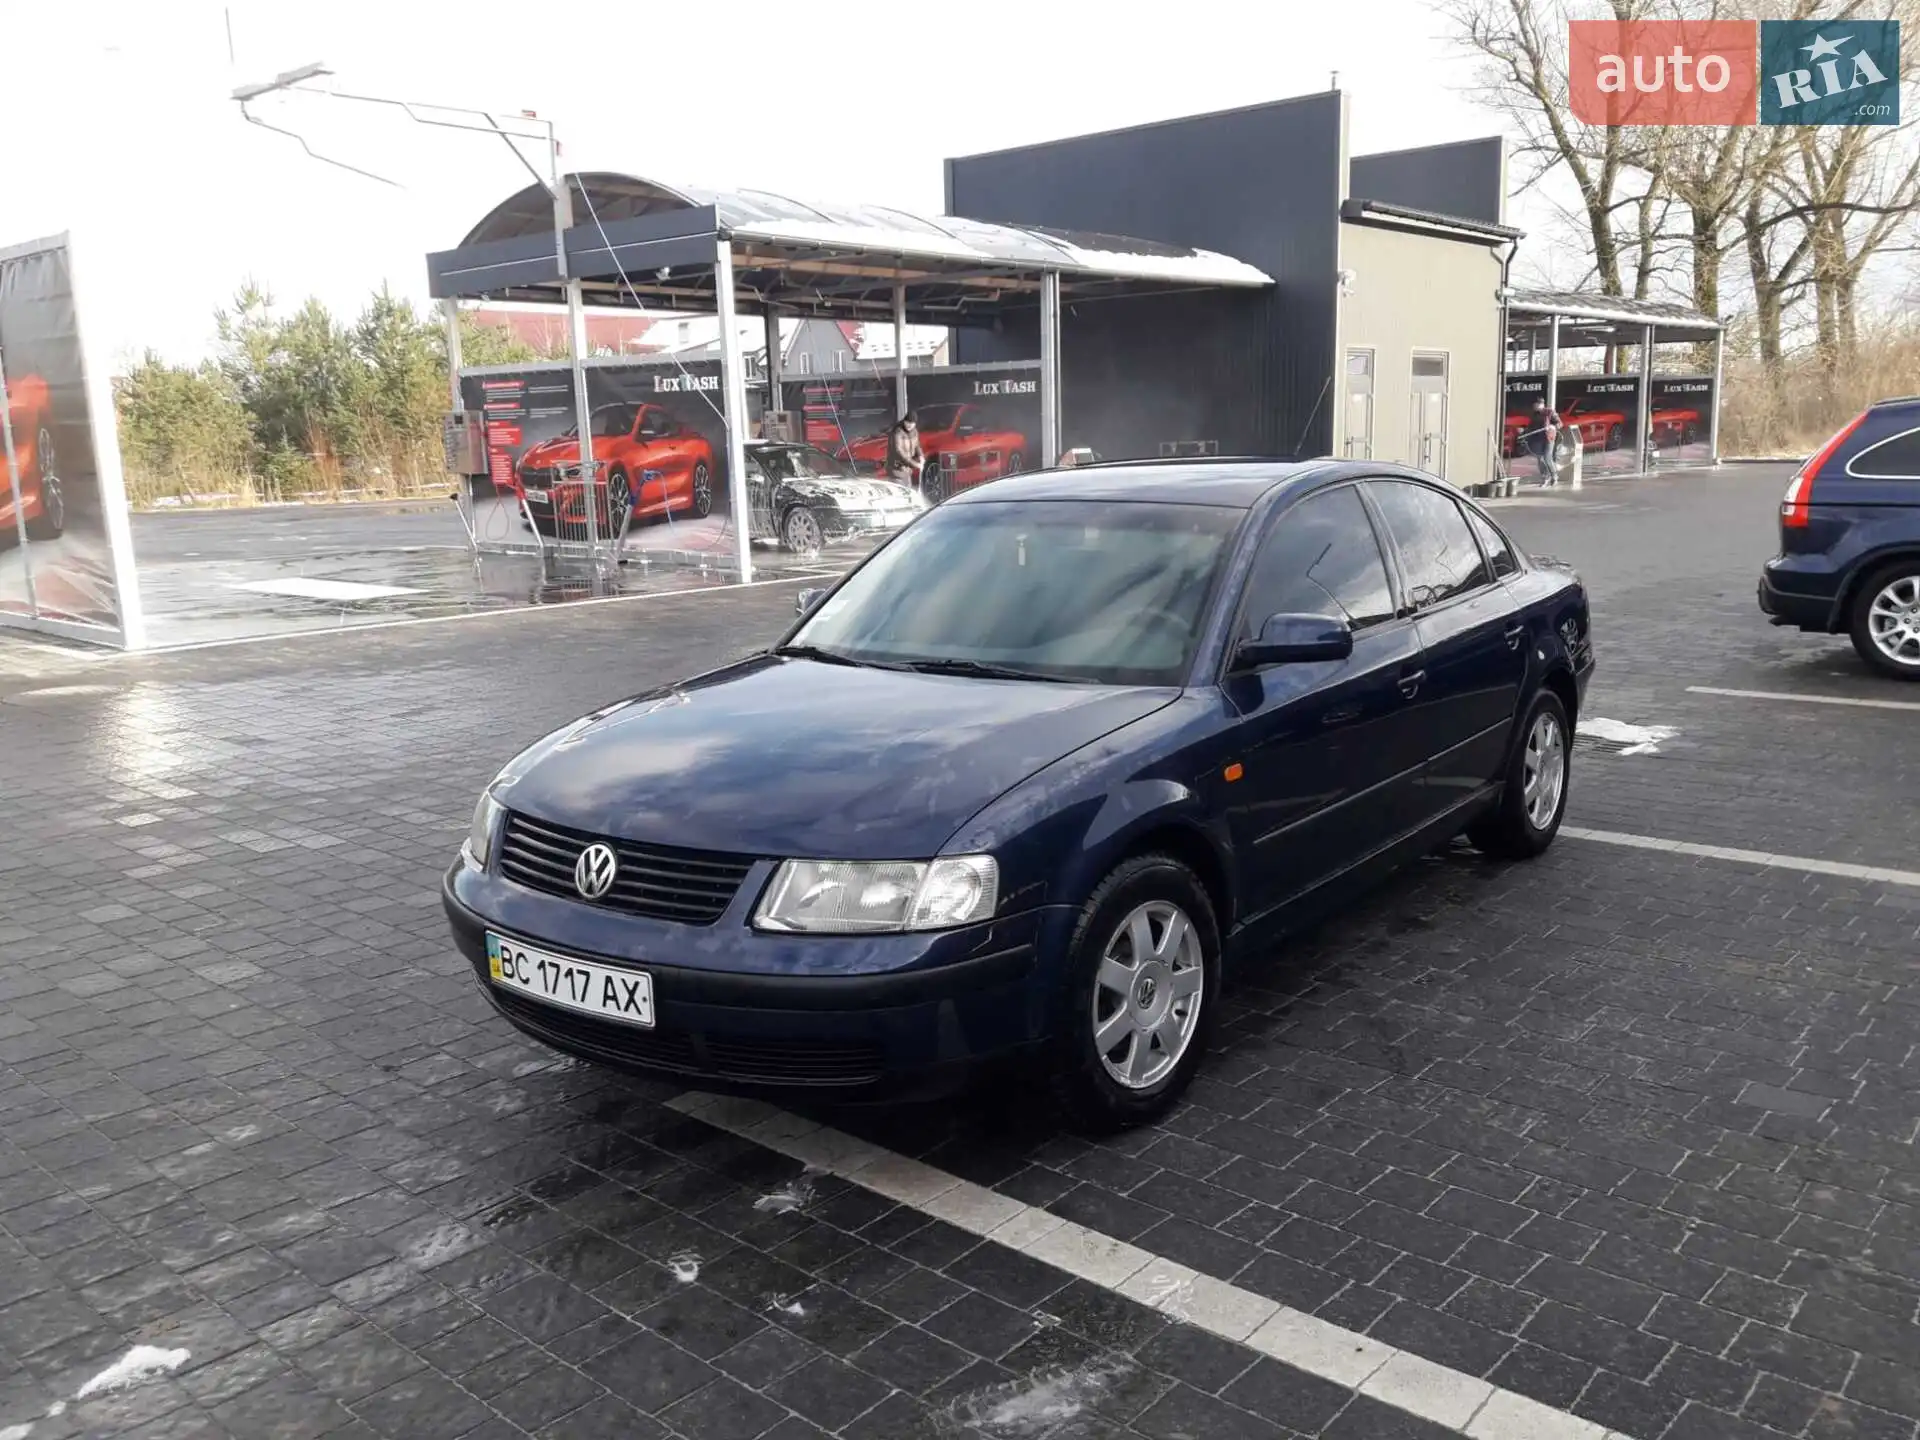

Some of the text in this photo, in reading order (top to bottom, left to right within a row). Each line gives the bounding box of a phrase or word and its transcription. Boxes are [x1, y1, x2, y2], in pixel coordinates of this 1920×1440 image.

[654, 375, 680, 393] LUX
[973, 380, 1000, 396] LUX
[575, 843, 616, 898] VW
[500, 945, 643, 1015] BC 1717 AX
